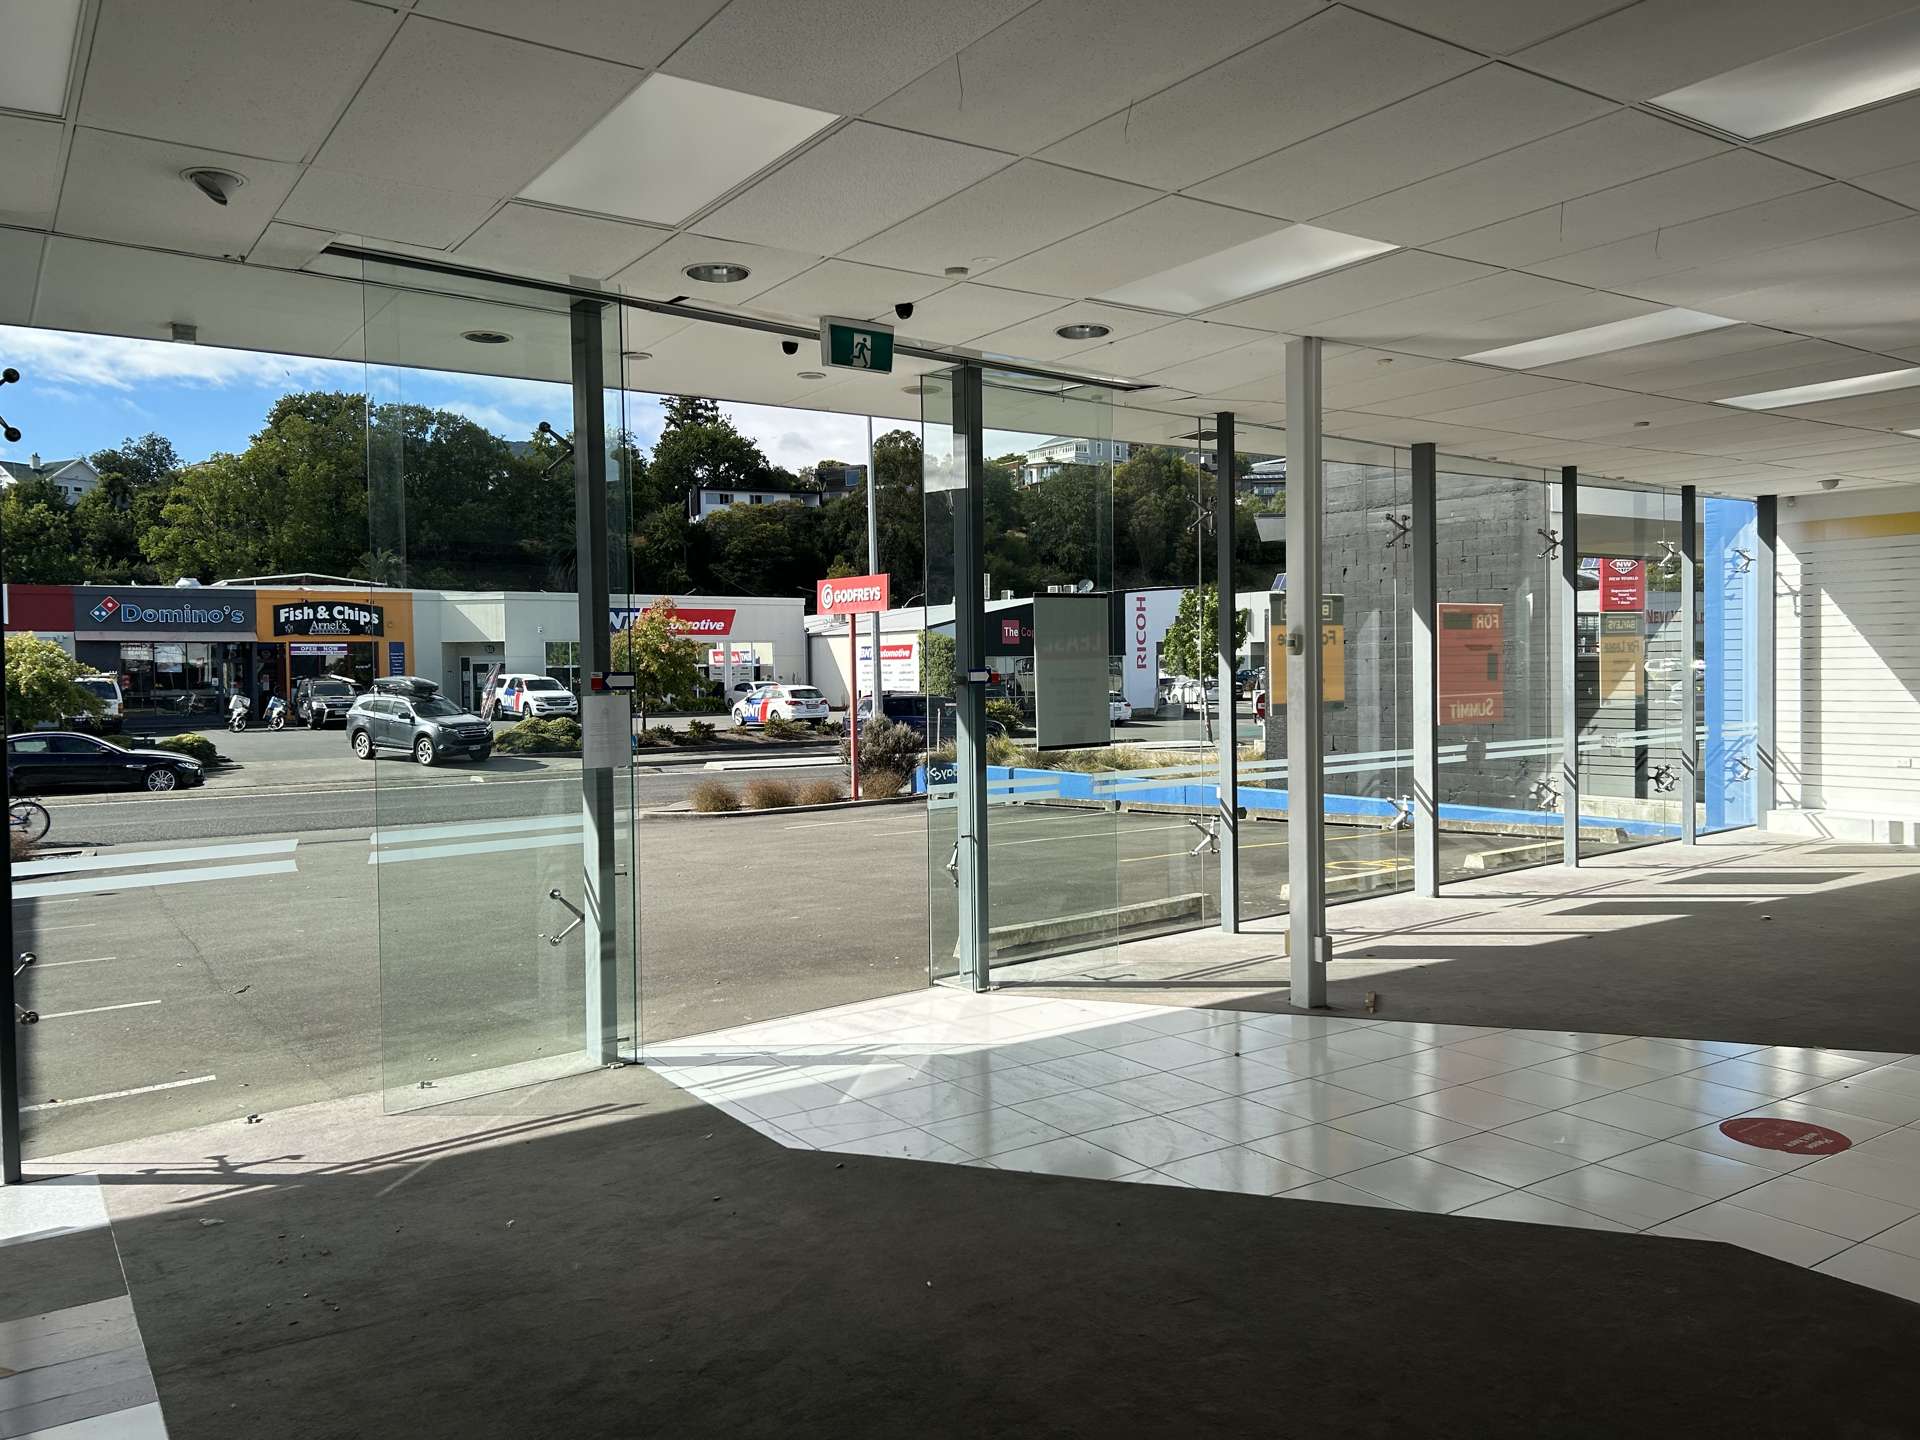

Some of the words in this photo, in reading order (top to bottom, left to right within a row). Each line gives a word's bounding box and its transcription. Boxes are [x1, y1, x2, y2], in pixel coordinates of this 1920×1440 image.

[834, 586, 881, 604] GODFREYS
[121, 603, 245, 624] Domino's
[280, 606, 314, 622] Fish
[317, 606, 330, 620] &
[333, 606, 379, 625] Chips
[311, 620, 349, 632] Arnel's
[1003, 626, 1019, 637] The
[1136, 596, 1147, 669] RICOH
[880, 648, 910, 658] utomotive
